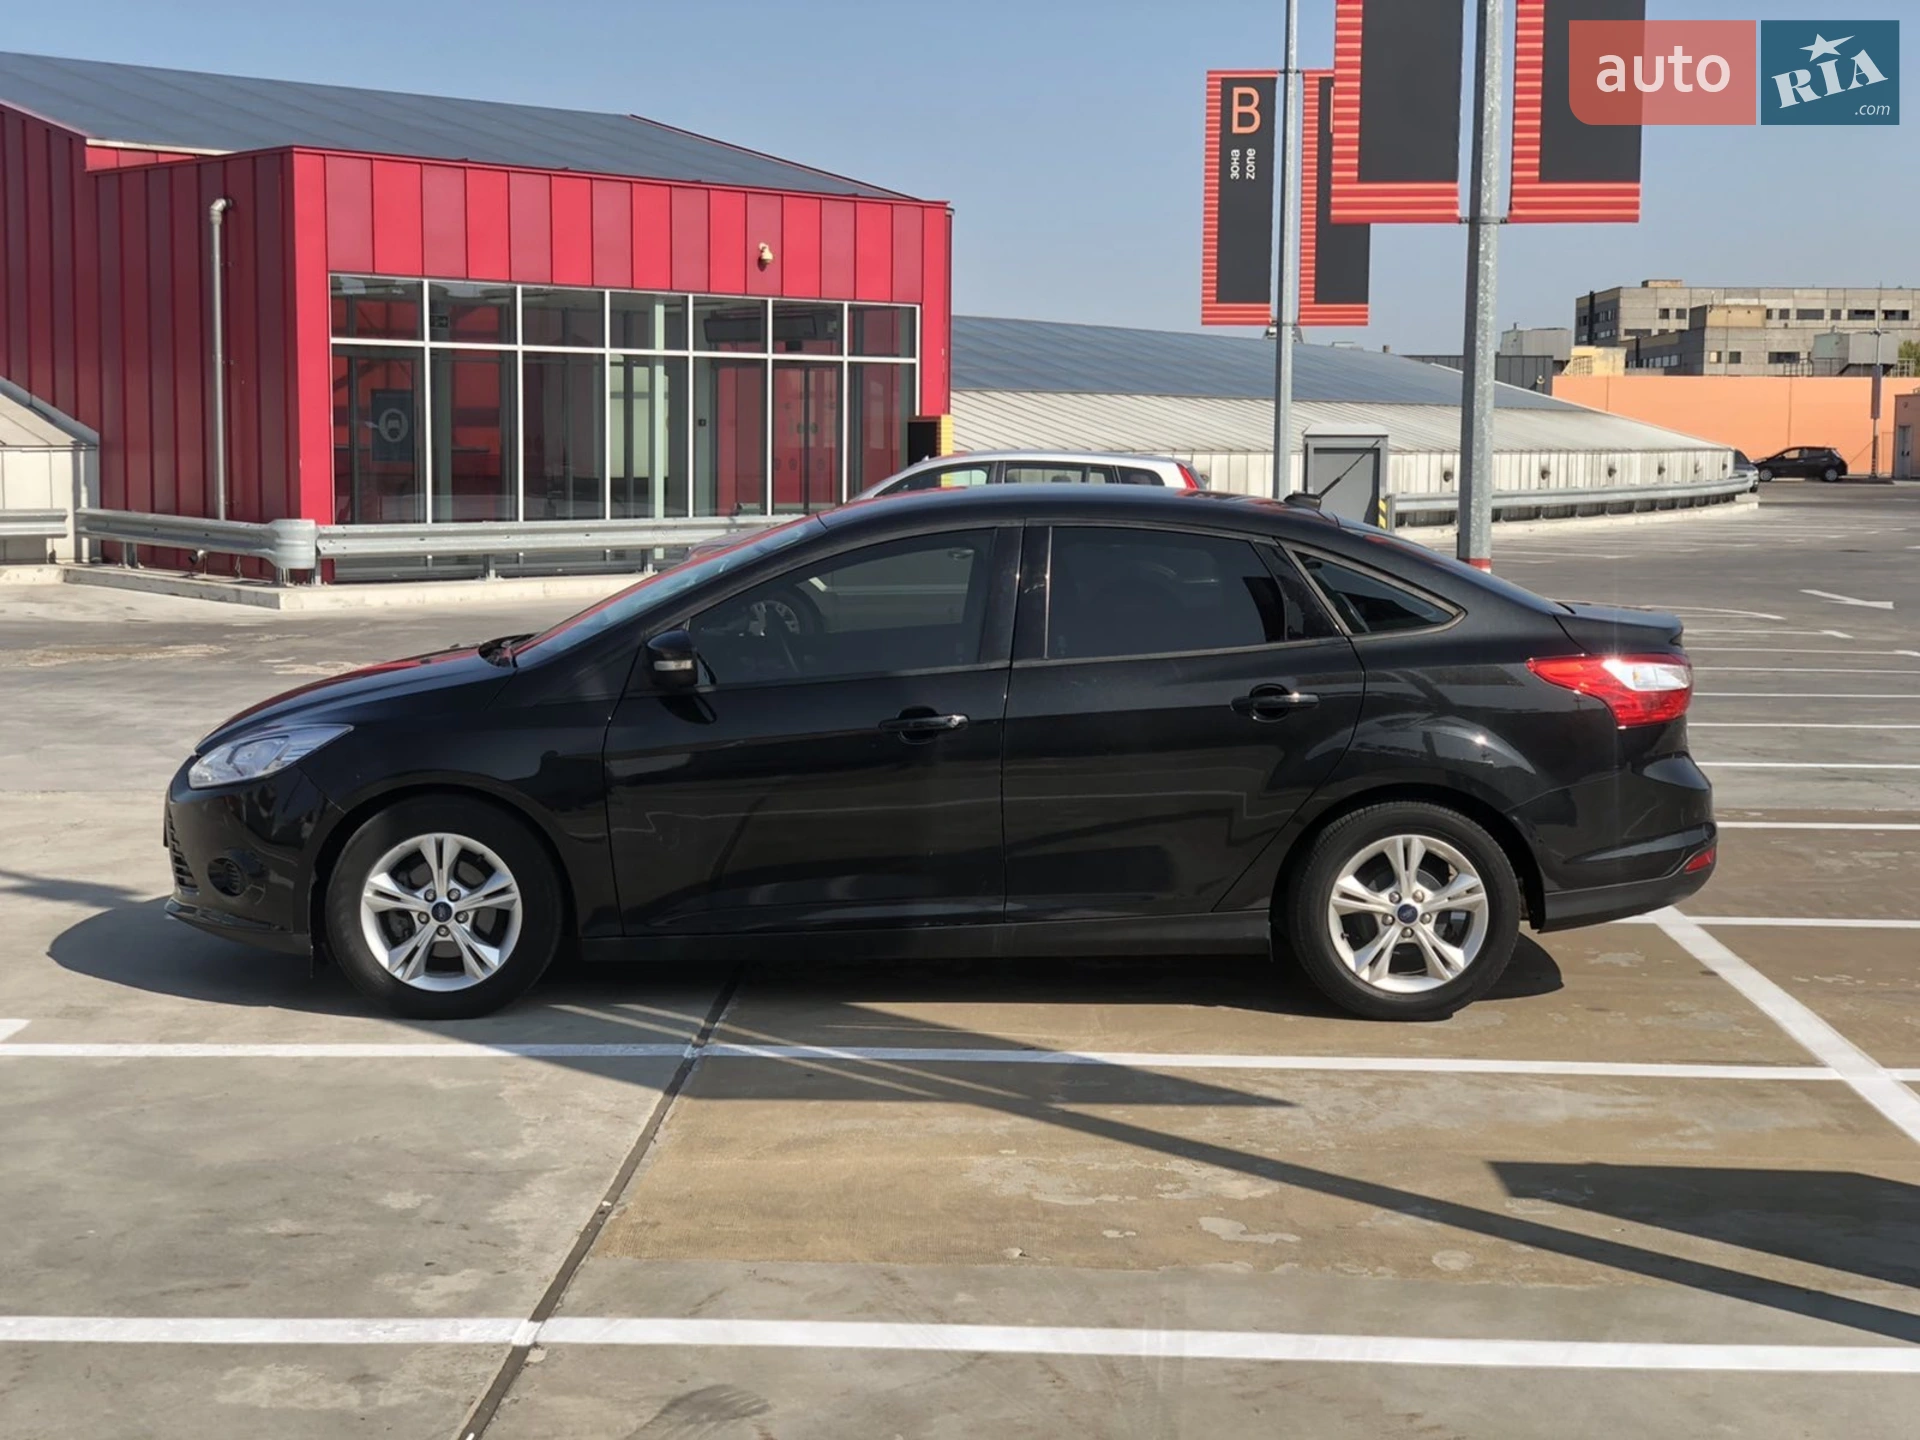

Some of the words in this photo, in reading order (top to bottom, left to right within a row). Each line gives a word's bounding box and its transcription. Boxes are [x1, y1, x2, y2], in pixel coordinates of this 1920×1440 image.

[1231, 86, 1261, 134] B
[1230, 149, 1241, 180] зона
[1245, 148, 1256, 180] zone
